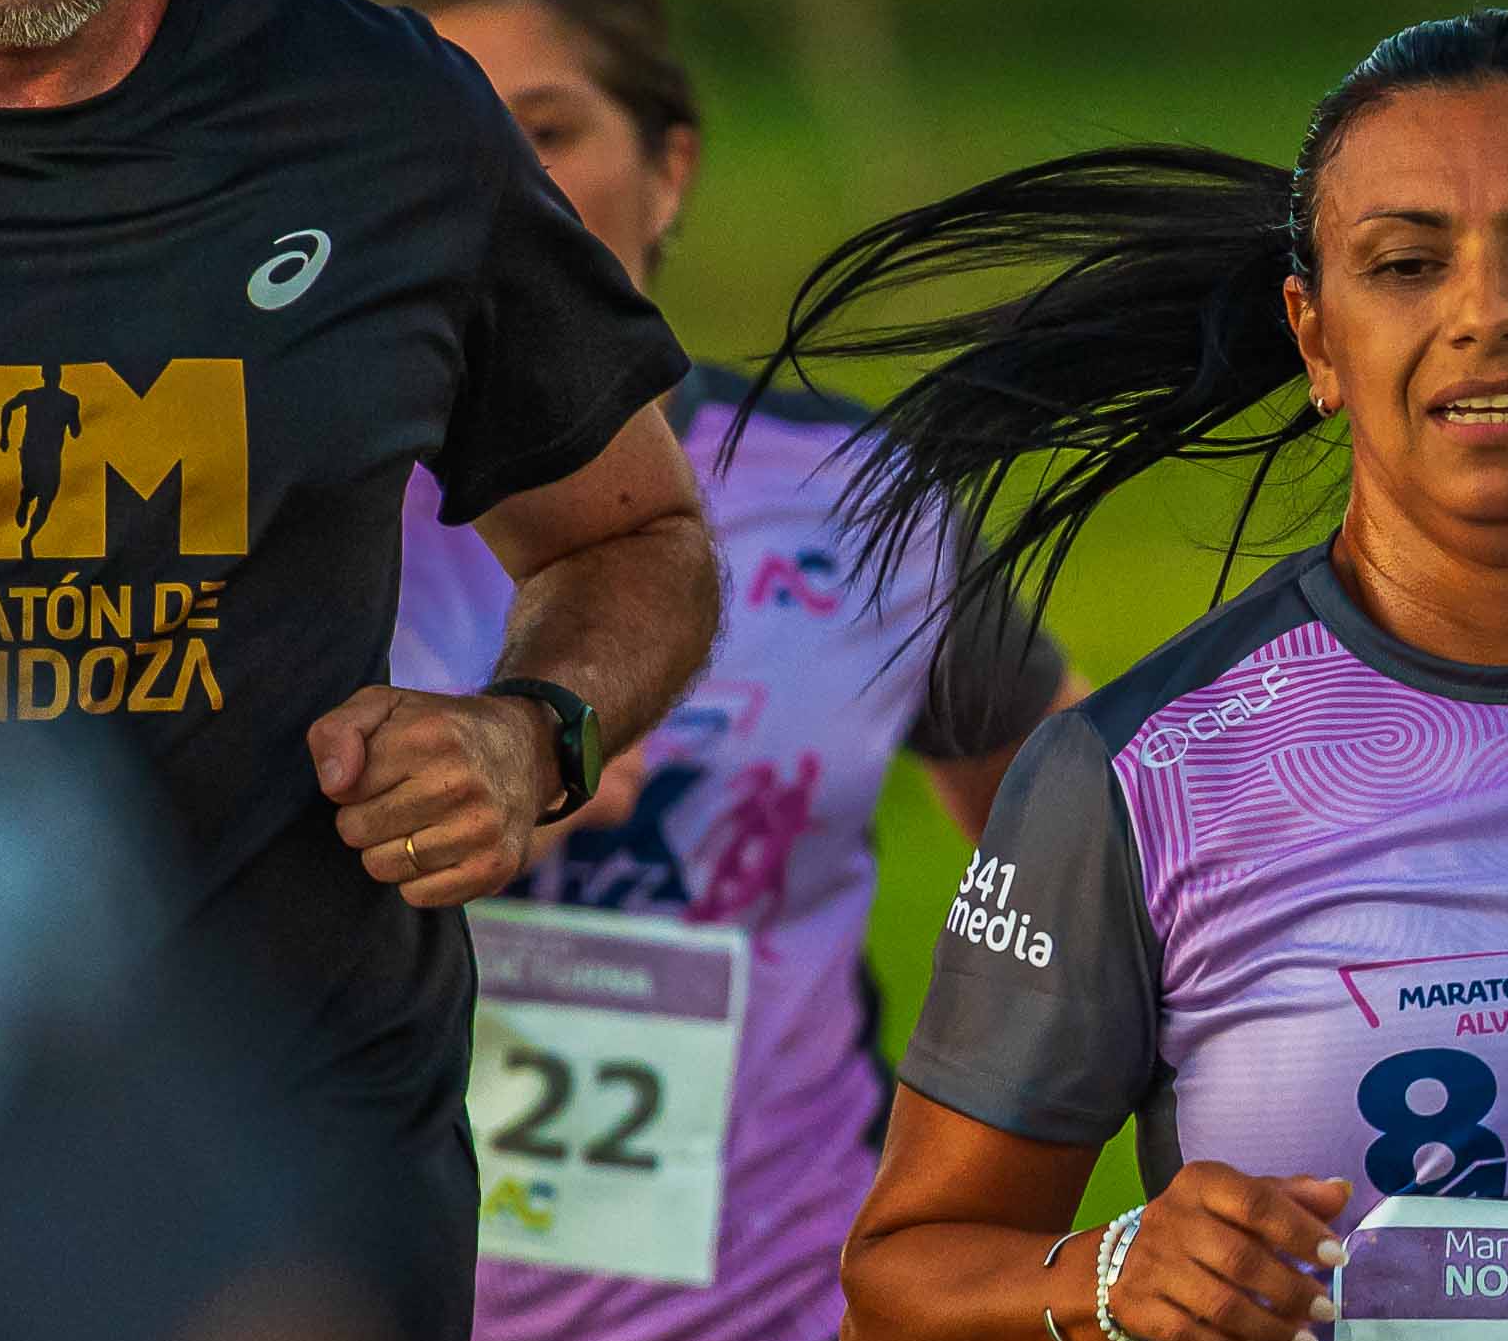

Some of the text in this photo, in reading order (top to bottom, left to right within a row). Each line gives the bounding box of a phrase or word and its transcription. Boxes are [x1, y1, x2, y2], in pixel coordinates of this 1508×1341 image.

[153, 580, 227, 635] DE
[959, 846, 1017, 910] 341
[946, 896, 1053, 968] media
